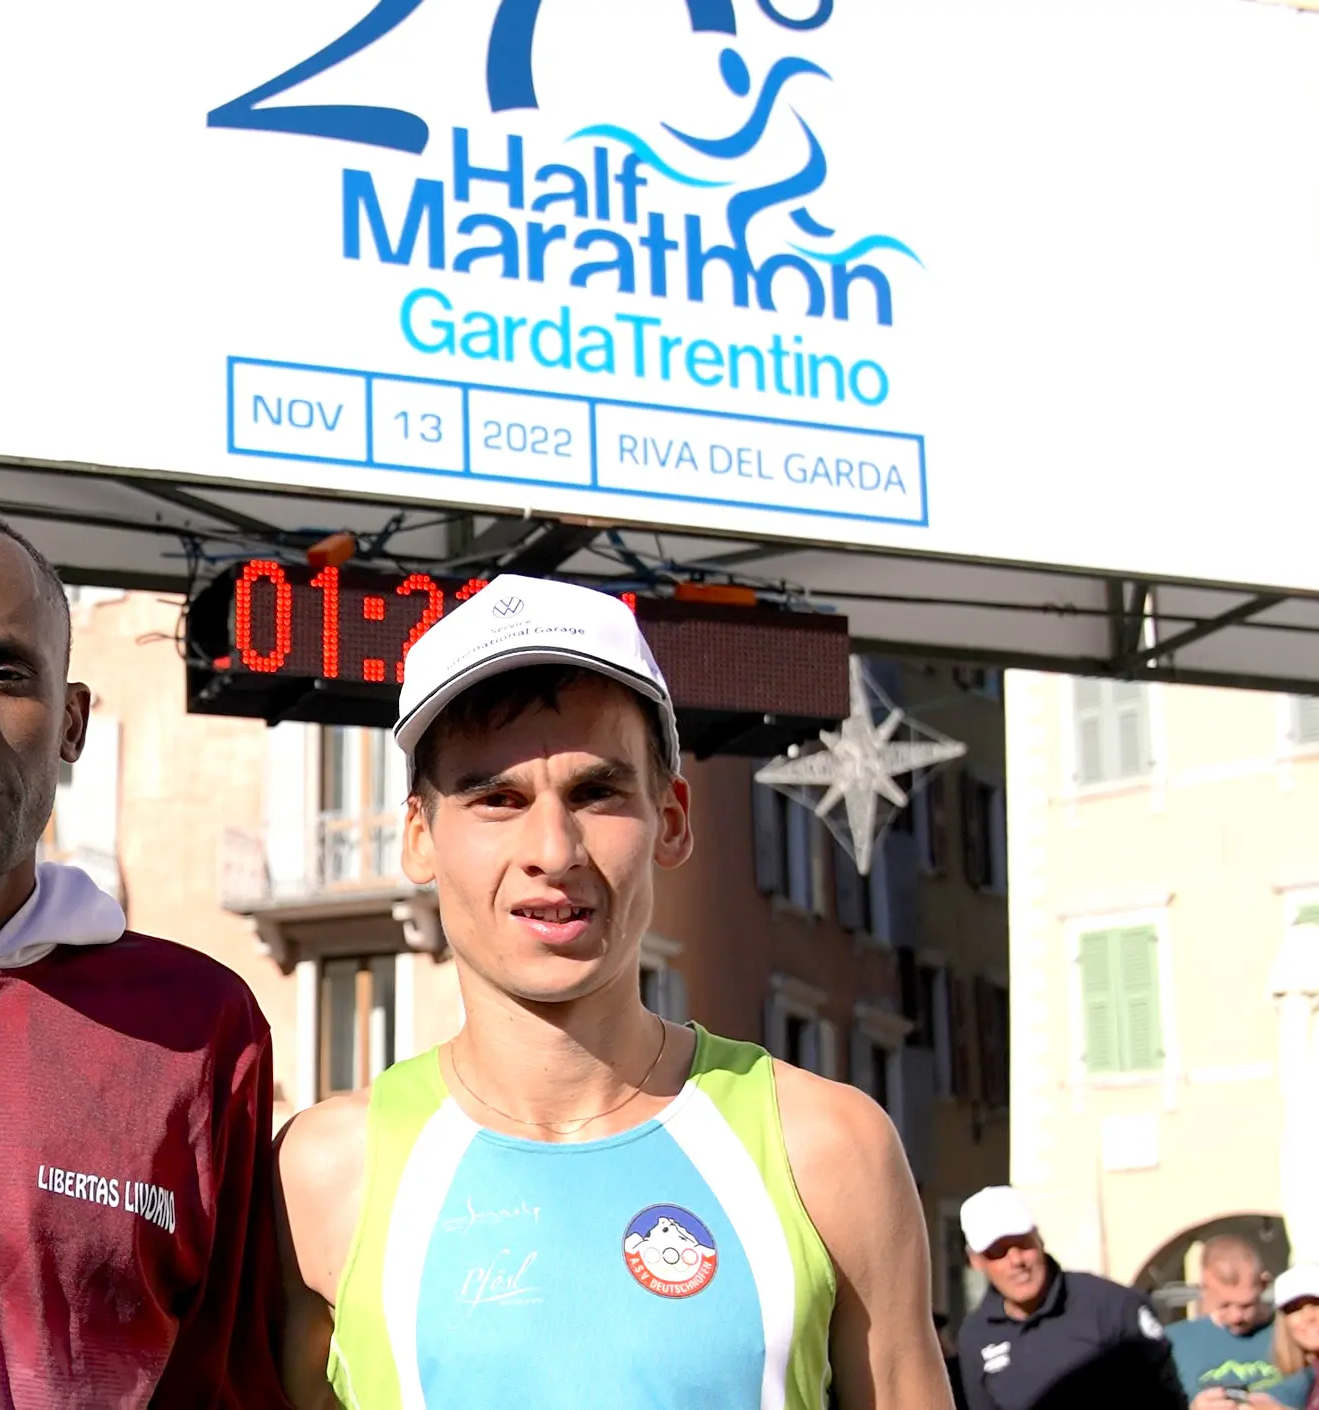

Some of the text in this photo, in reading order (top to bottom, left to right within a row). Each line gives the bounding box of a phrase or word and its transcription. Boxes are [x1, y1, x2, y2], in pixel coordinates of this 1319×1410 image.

[451, 126, 650, 224] Half
[342, 168, 894, 327] Marathon
[399, 287, 891, 407] GardaTrentino
[252, 394, 907, 495] NOV 13 2022 RIVA DEL GARDA
[235, 559, 489, 683] 01:2
[534, 626, 586, 635] Garage
[38, 1164, 176, 1234] LIBERTAS LIVORNO
